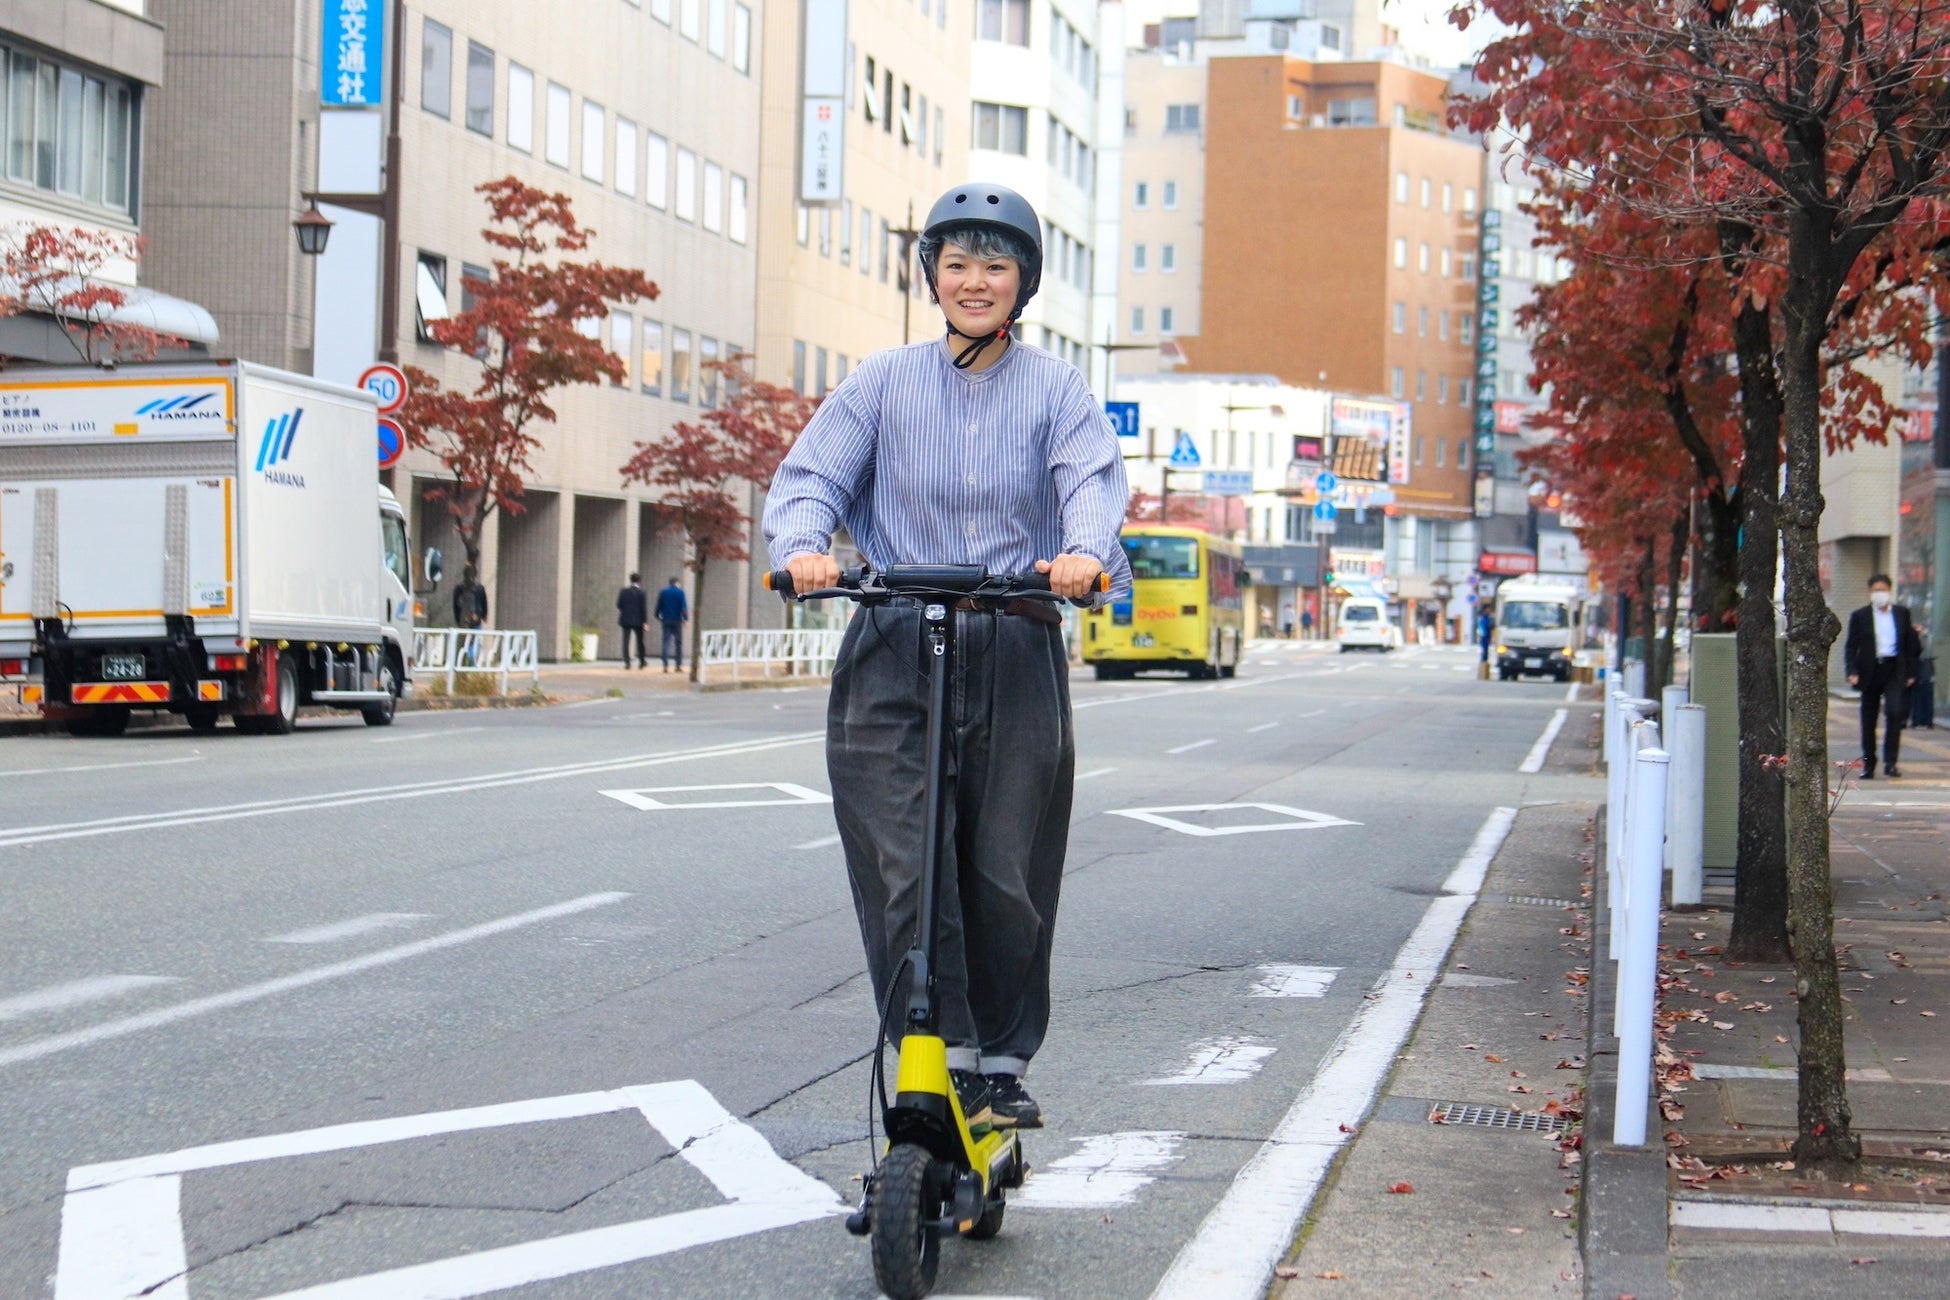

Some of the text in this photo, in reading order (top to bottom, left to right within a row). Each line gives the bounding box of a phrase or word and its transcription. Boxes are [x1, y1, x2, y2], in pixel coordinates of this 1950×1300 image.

[368, 377, 396, 400] 50
[151, 411, 221, 421] HAMANA
[264, 469, 306, 488] HAMANA
